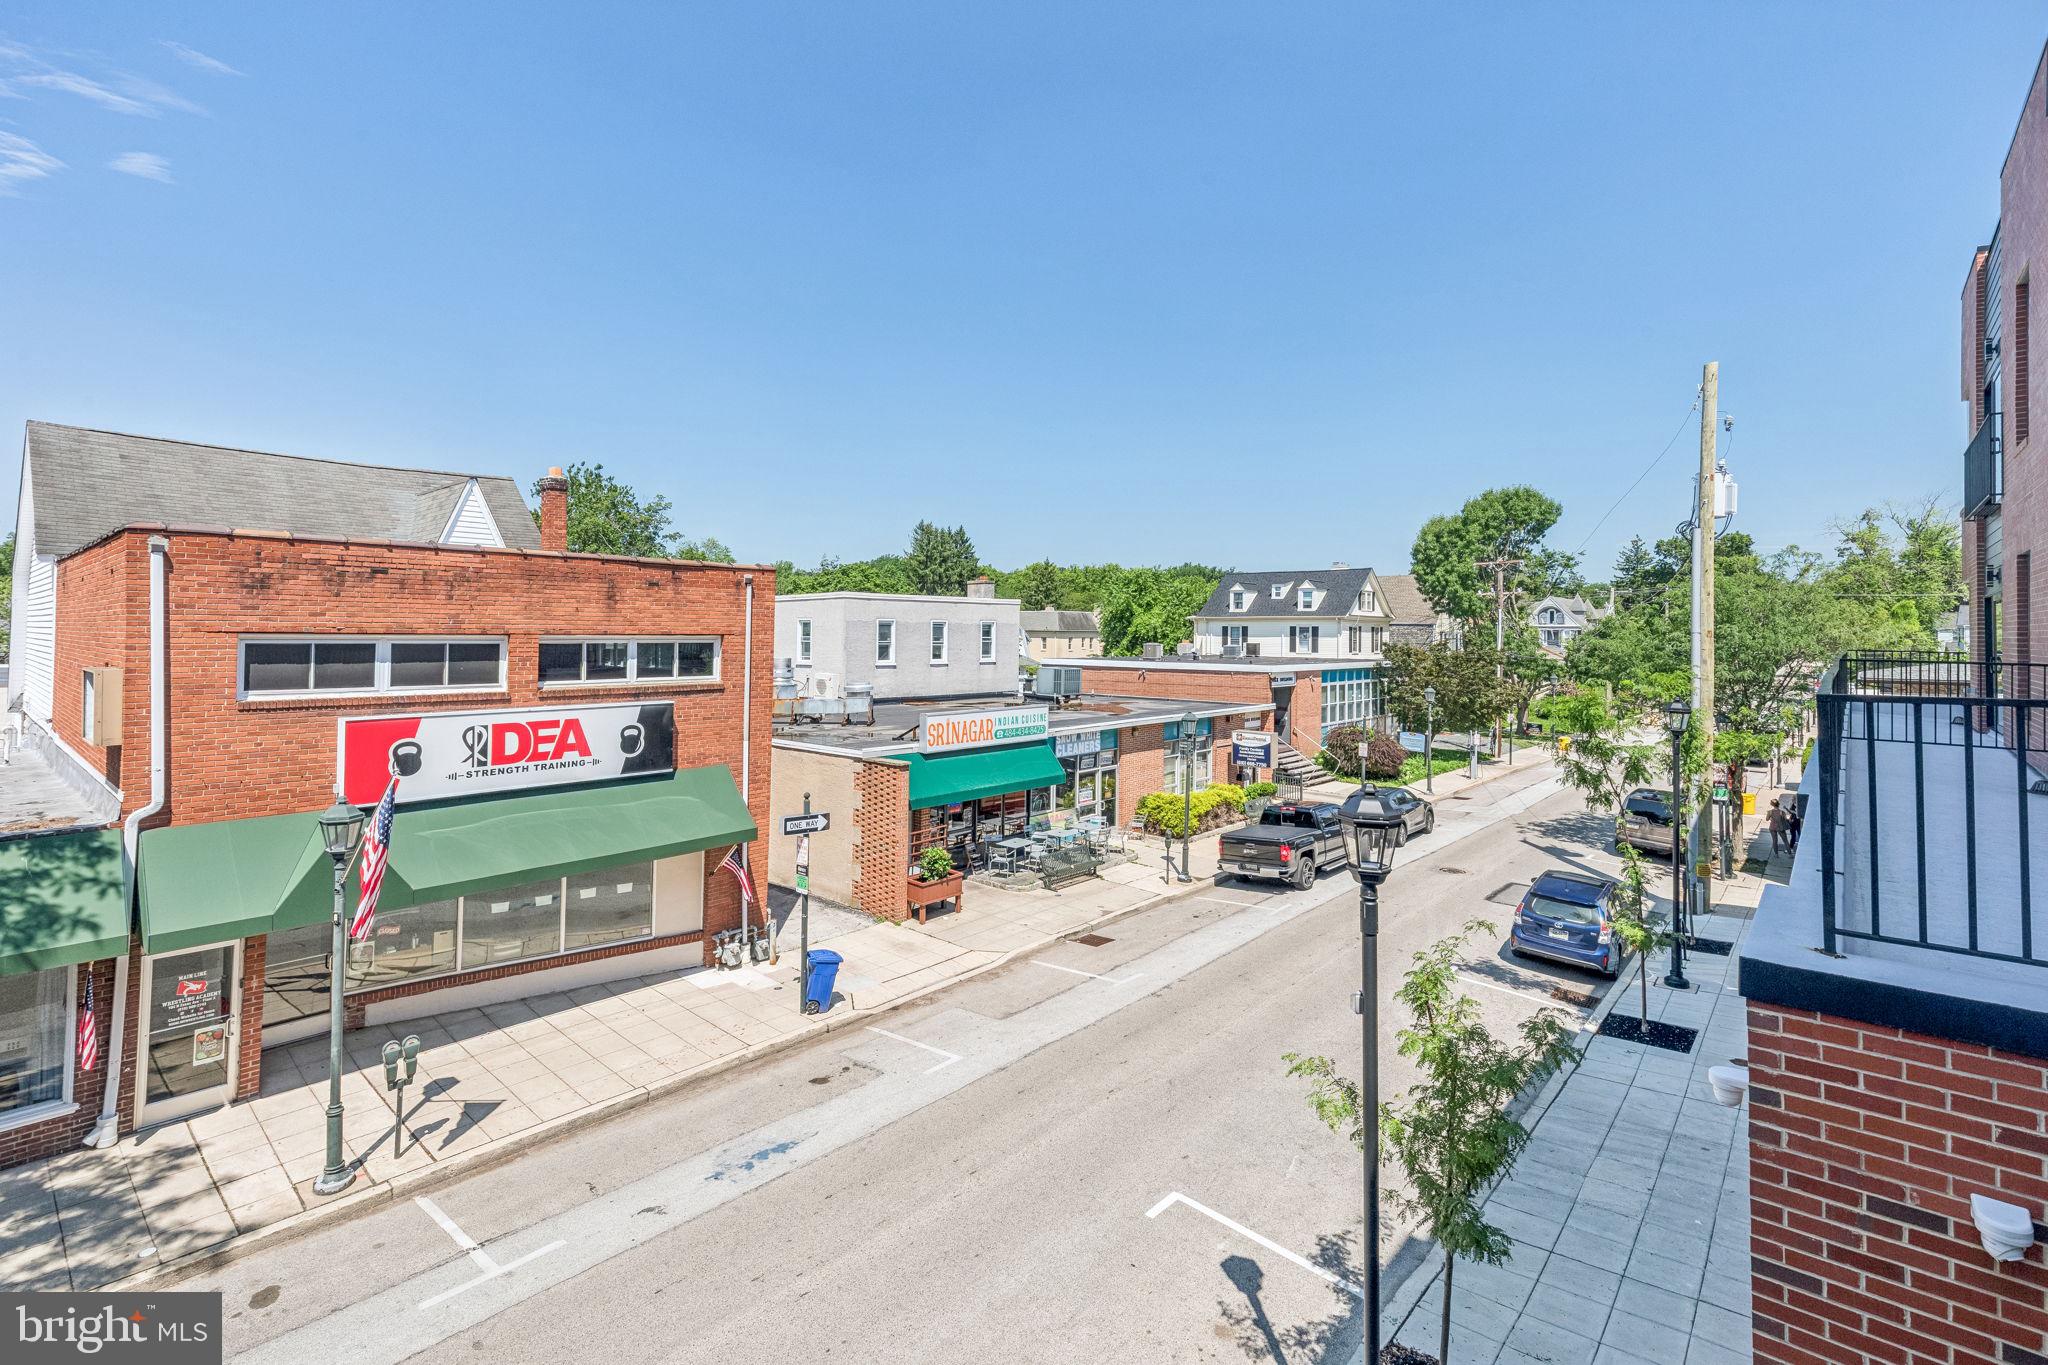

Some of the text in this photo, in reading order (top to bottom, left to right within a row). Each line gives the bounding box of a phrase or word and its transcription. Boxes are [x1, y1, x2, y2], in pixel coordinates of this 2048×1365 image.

[994, 712, 1047, 728] INDIAN CUISINE
[927, 718, 994, 747] SRINAGAR
[1003, 726, 1044, 737] 484-434-8425
[1056, 731, 1101, 744] SNOW WHITE
[1056, 740, 1101, 757] CLEANERS
[465, 759, 587, 779] STRENGTH TRAINING
[789, 819, 819, 830] ONE WAY
[178, 973, 193, 981] MAIN
[162, 990, 221, 1007] WRESTLING ACADEMY
